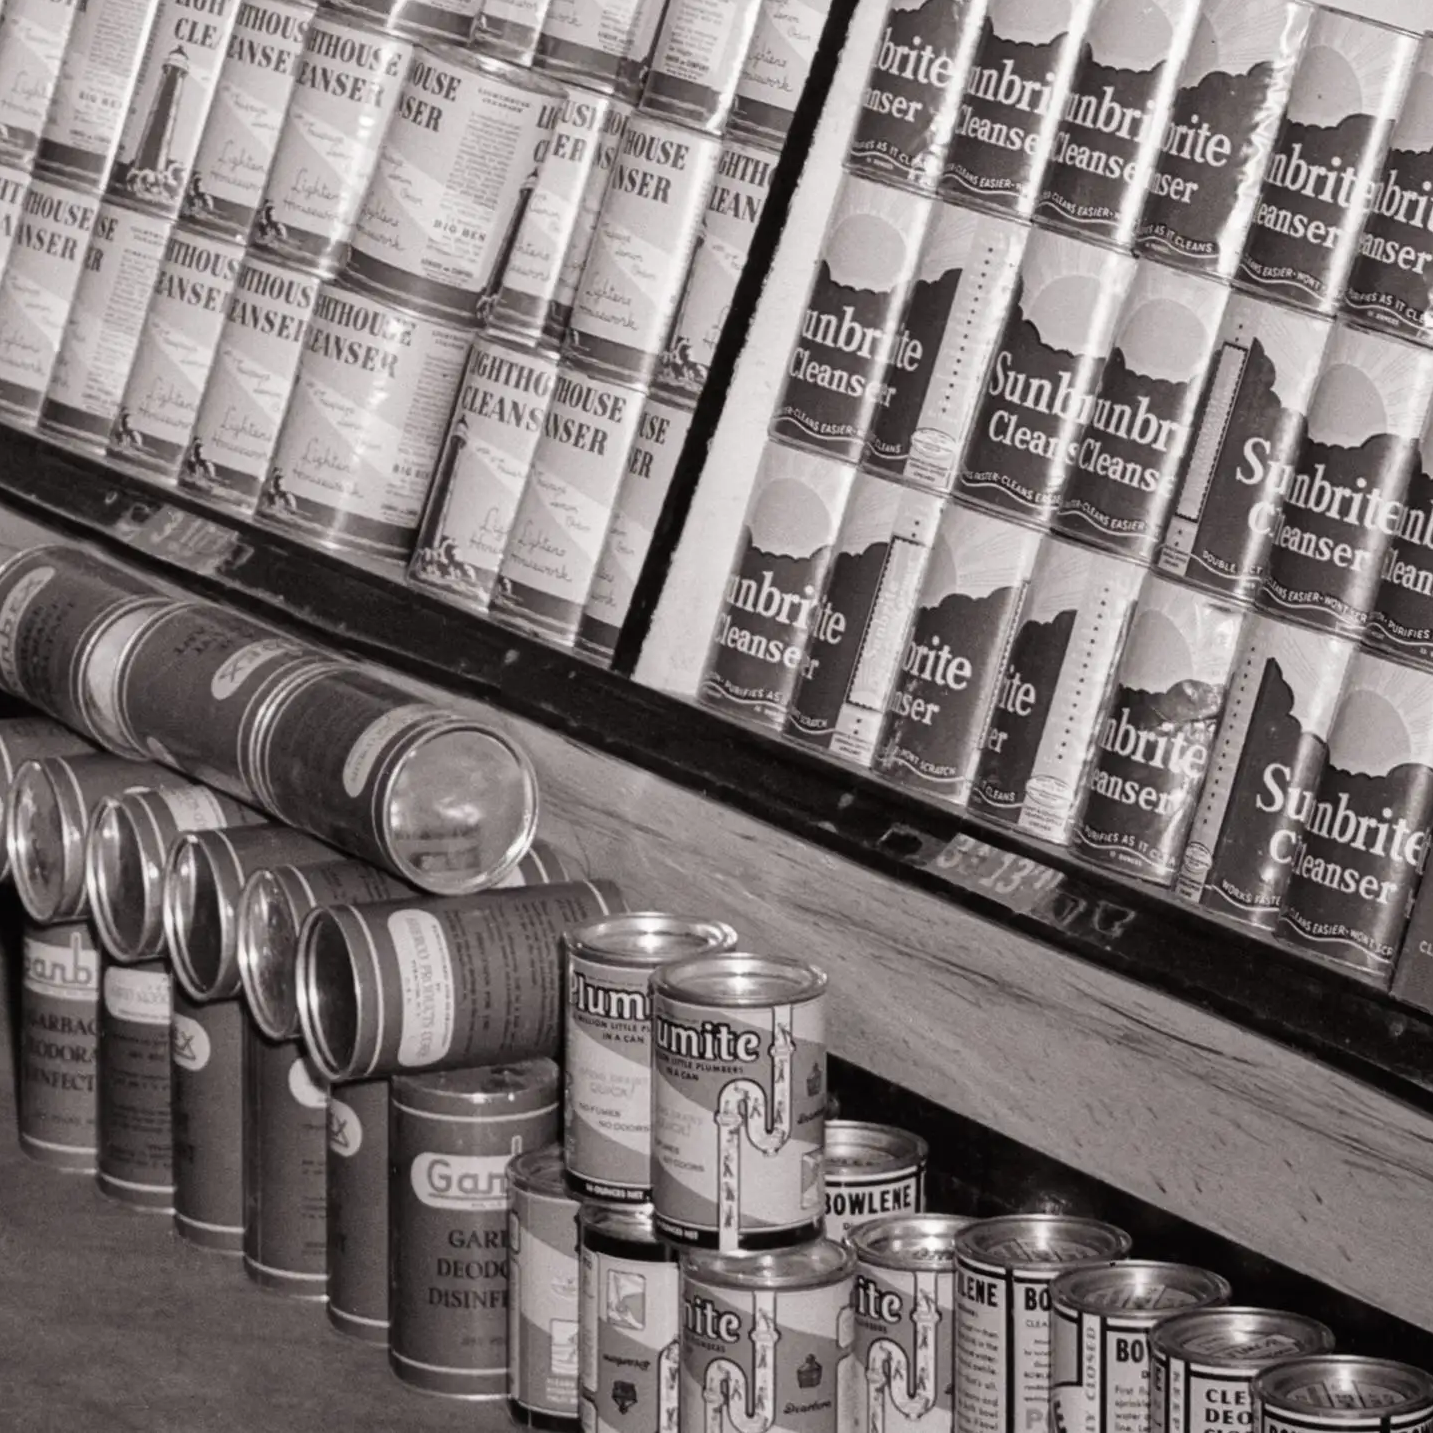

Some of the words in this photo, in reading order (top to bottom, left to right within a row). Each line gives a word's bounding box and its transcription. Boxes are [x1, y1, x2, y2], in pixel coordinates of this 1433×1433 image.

[469, 350, 552, 398] LIGHTHO
[1235, 440, 1399, 529] Sunbrite
[1249, 502, 1369, 573] Cleanser
